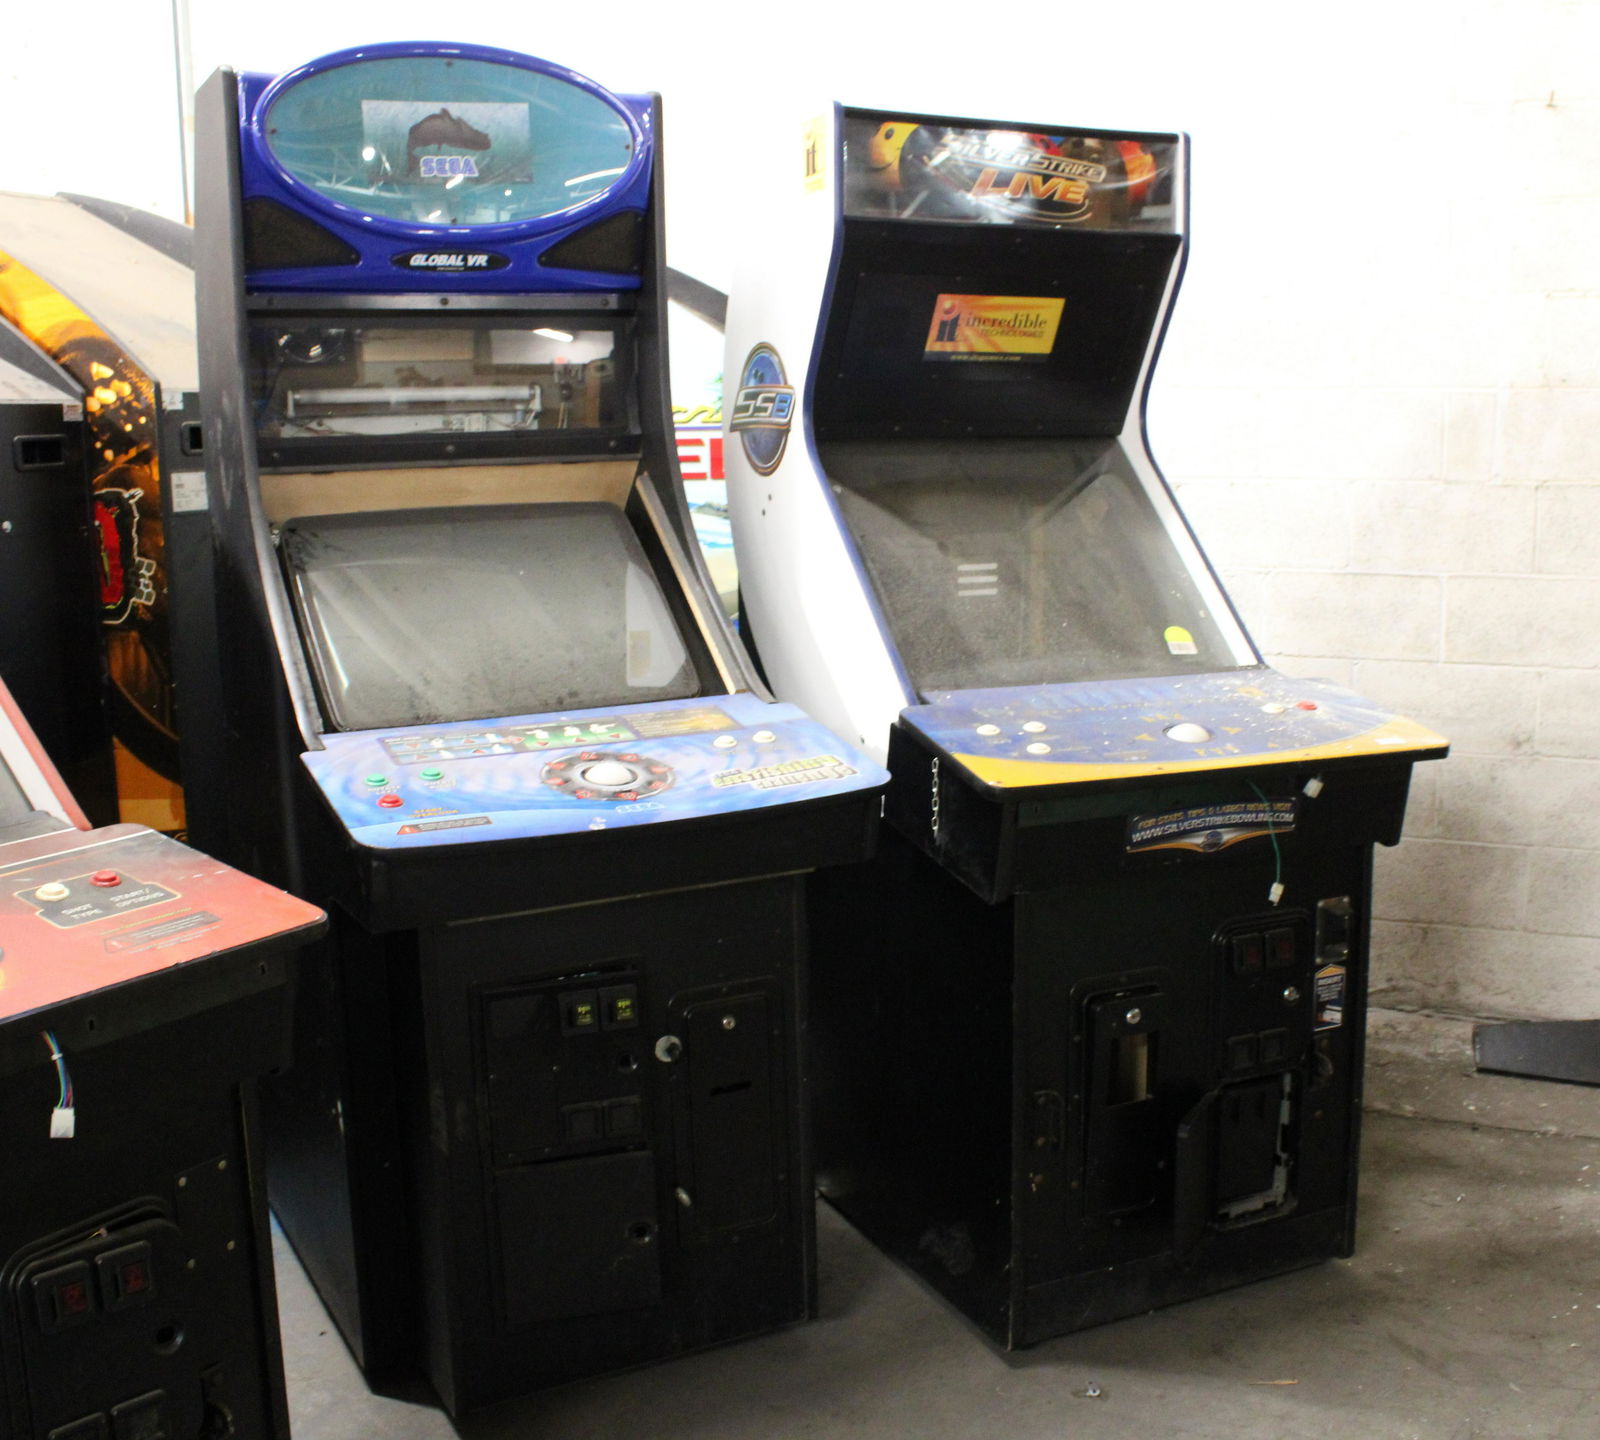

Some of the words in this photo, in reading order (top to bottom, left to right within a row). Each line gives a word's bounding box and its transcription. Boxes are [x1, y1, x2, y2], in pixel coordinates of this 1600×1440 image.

[420, 156, 479, 177] SEGA
[969, 166, 1089, 205] LIVE
[409, 253, 465, 267] GLOBAL
[466, 254, 489, 267] VR
[965, 311, 1048, 329] incredible
